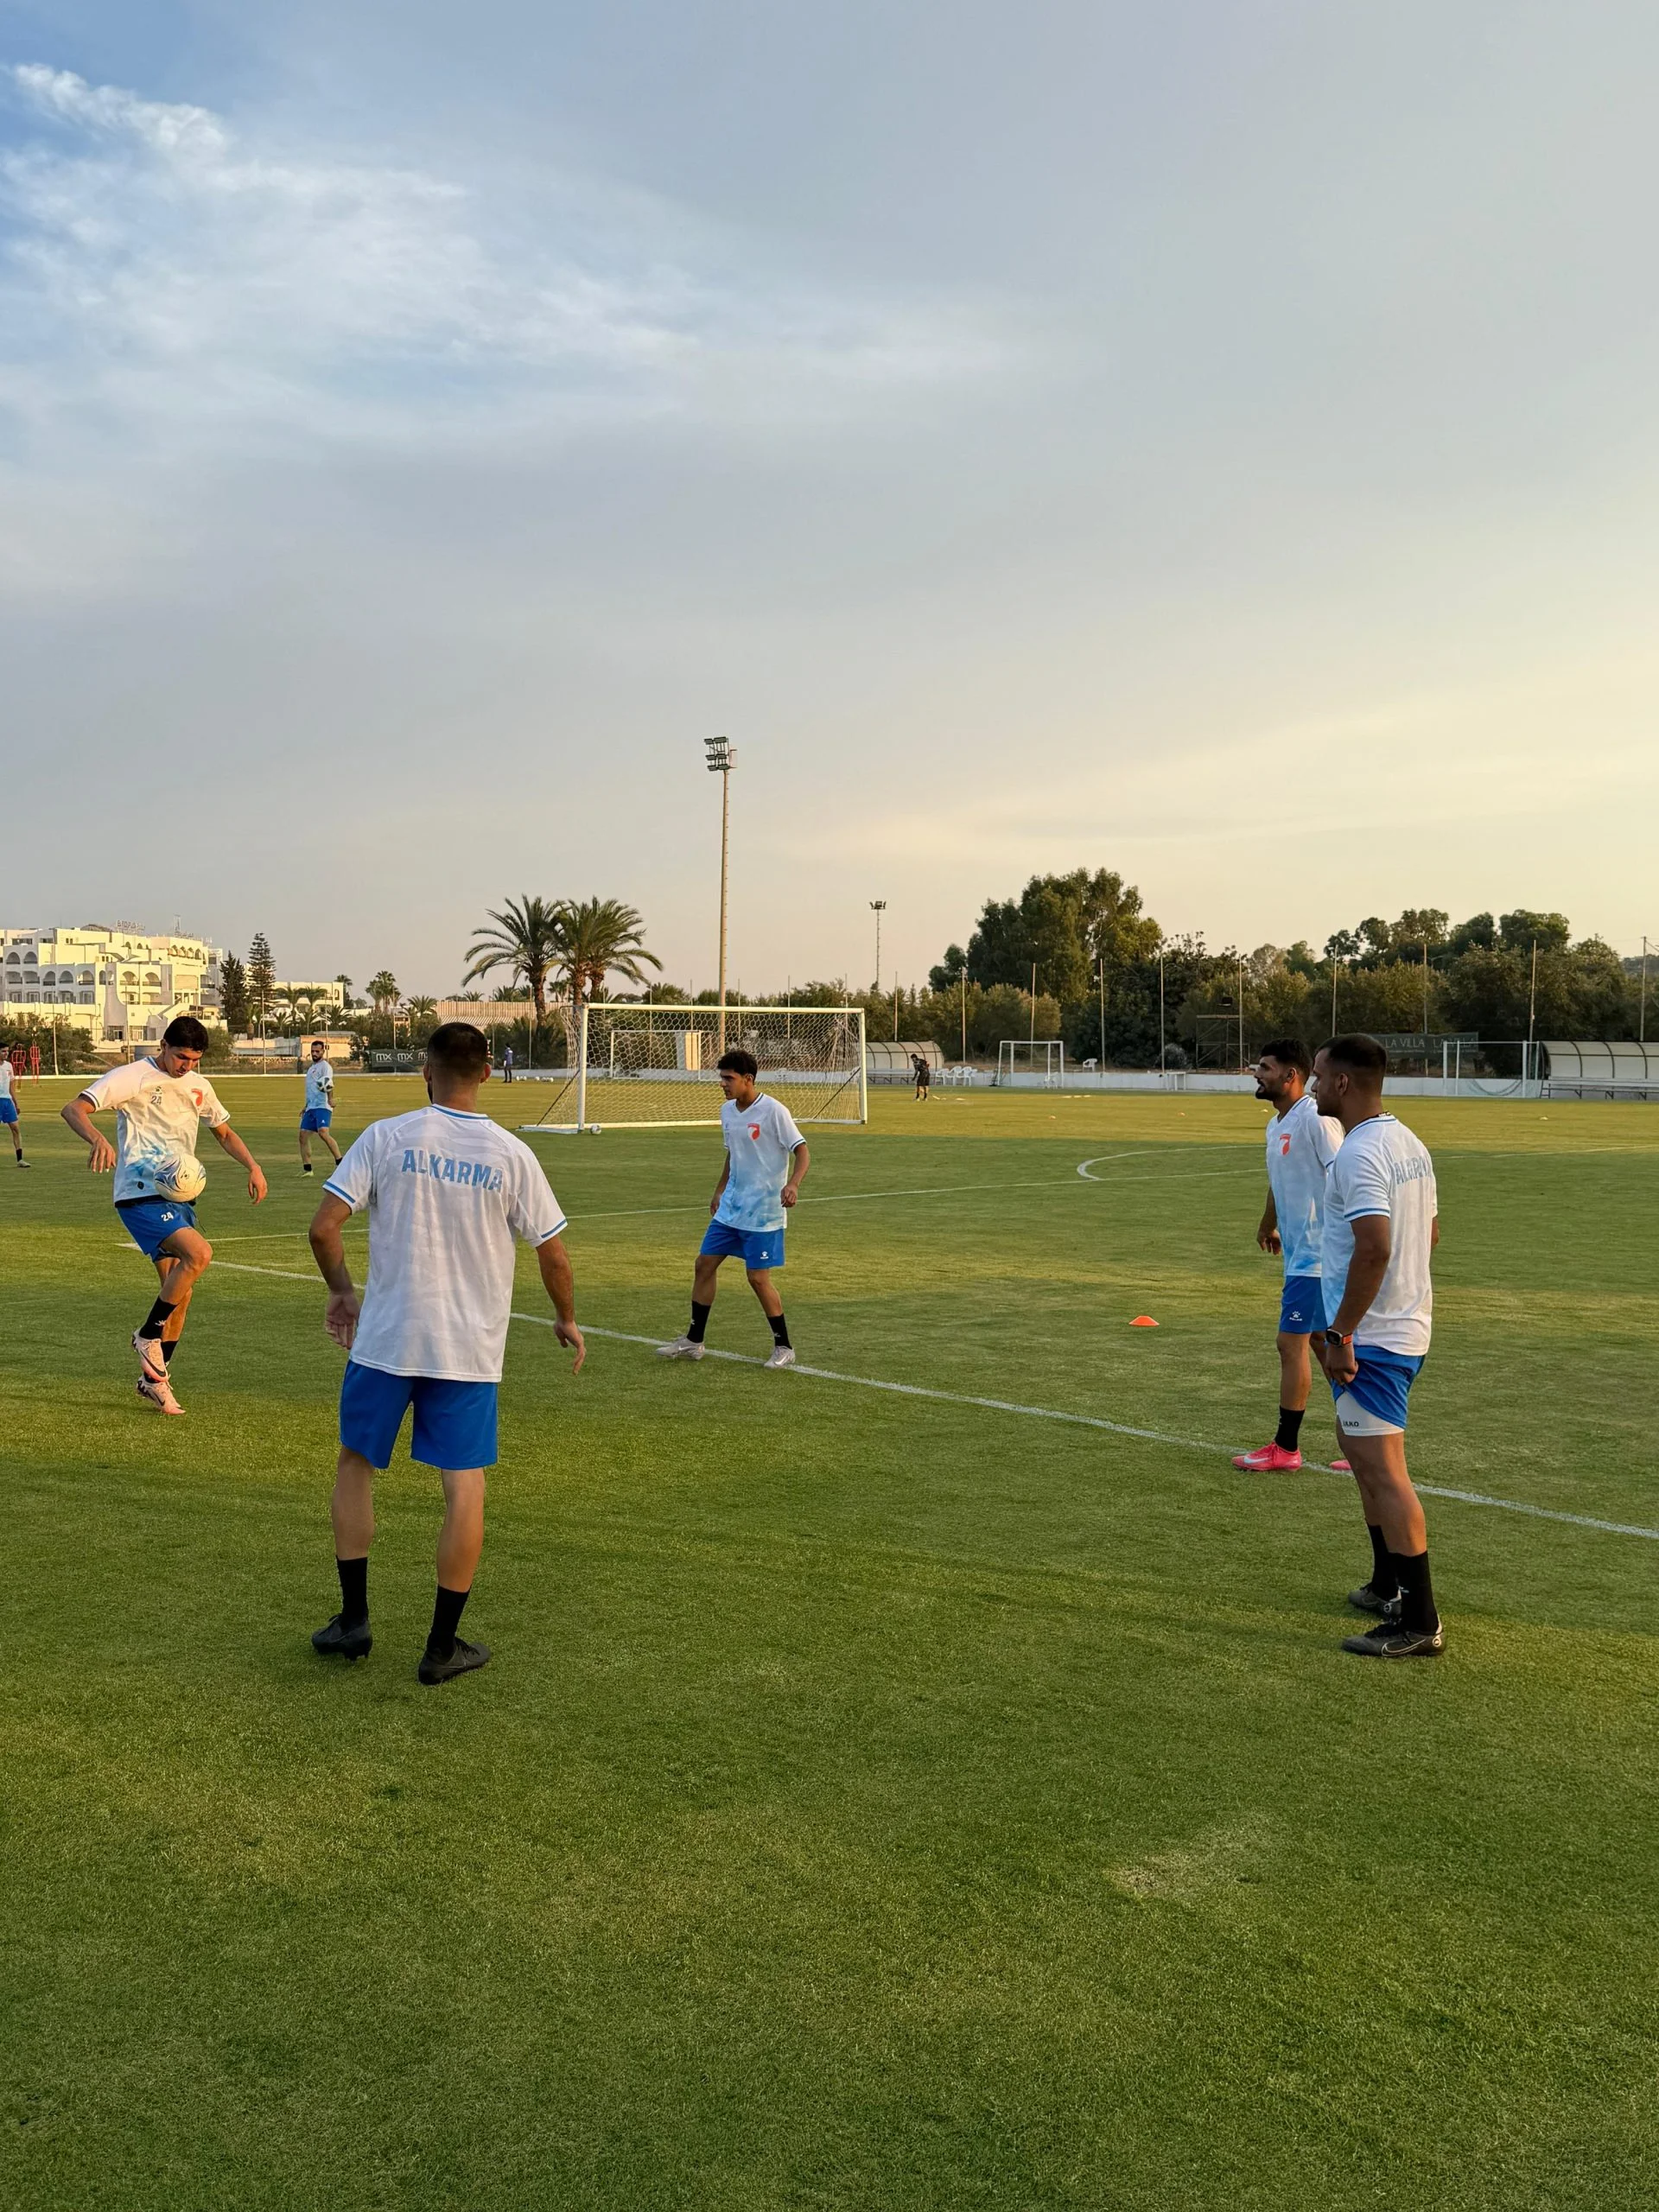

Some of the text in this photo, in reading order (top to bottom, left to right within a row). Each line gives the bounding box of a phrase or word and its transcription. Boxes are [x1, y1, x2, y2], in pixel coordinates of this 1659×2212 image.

[150, 1096, 162, 1105] 24
[402, 1149, 503, 1191] ALKARMA
[161, 1211, 174, 1222] 24
